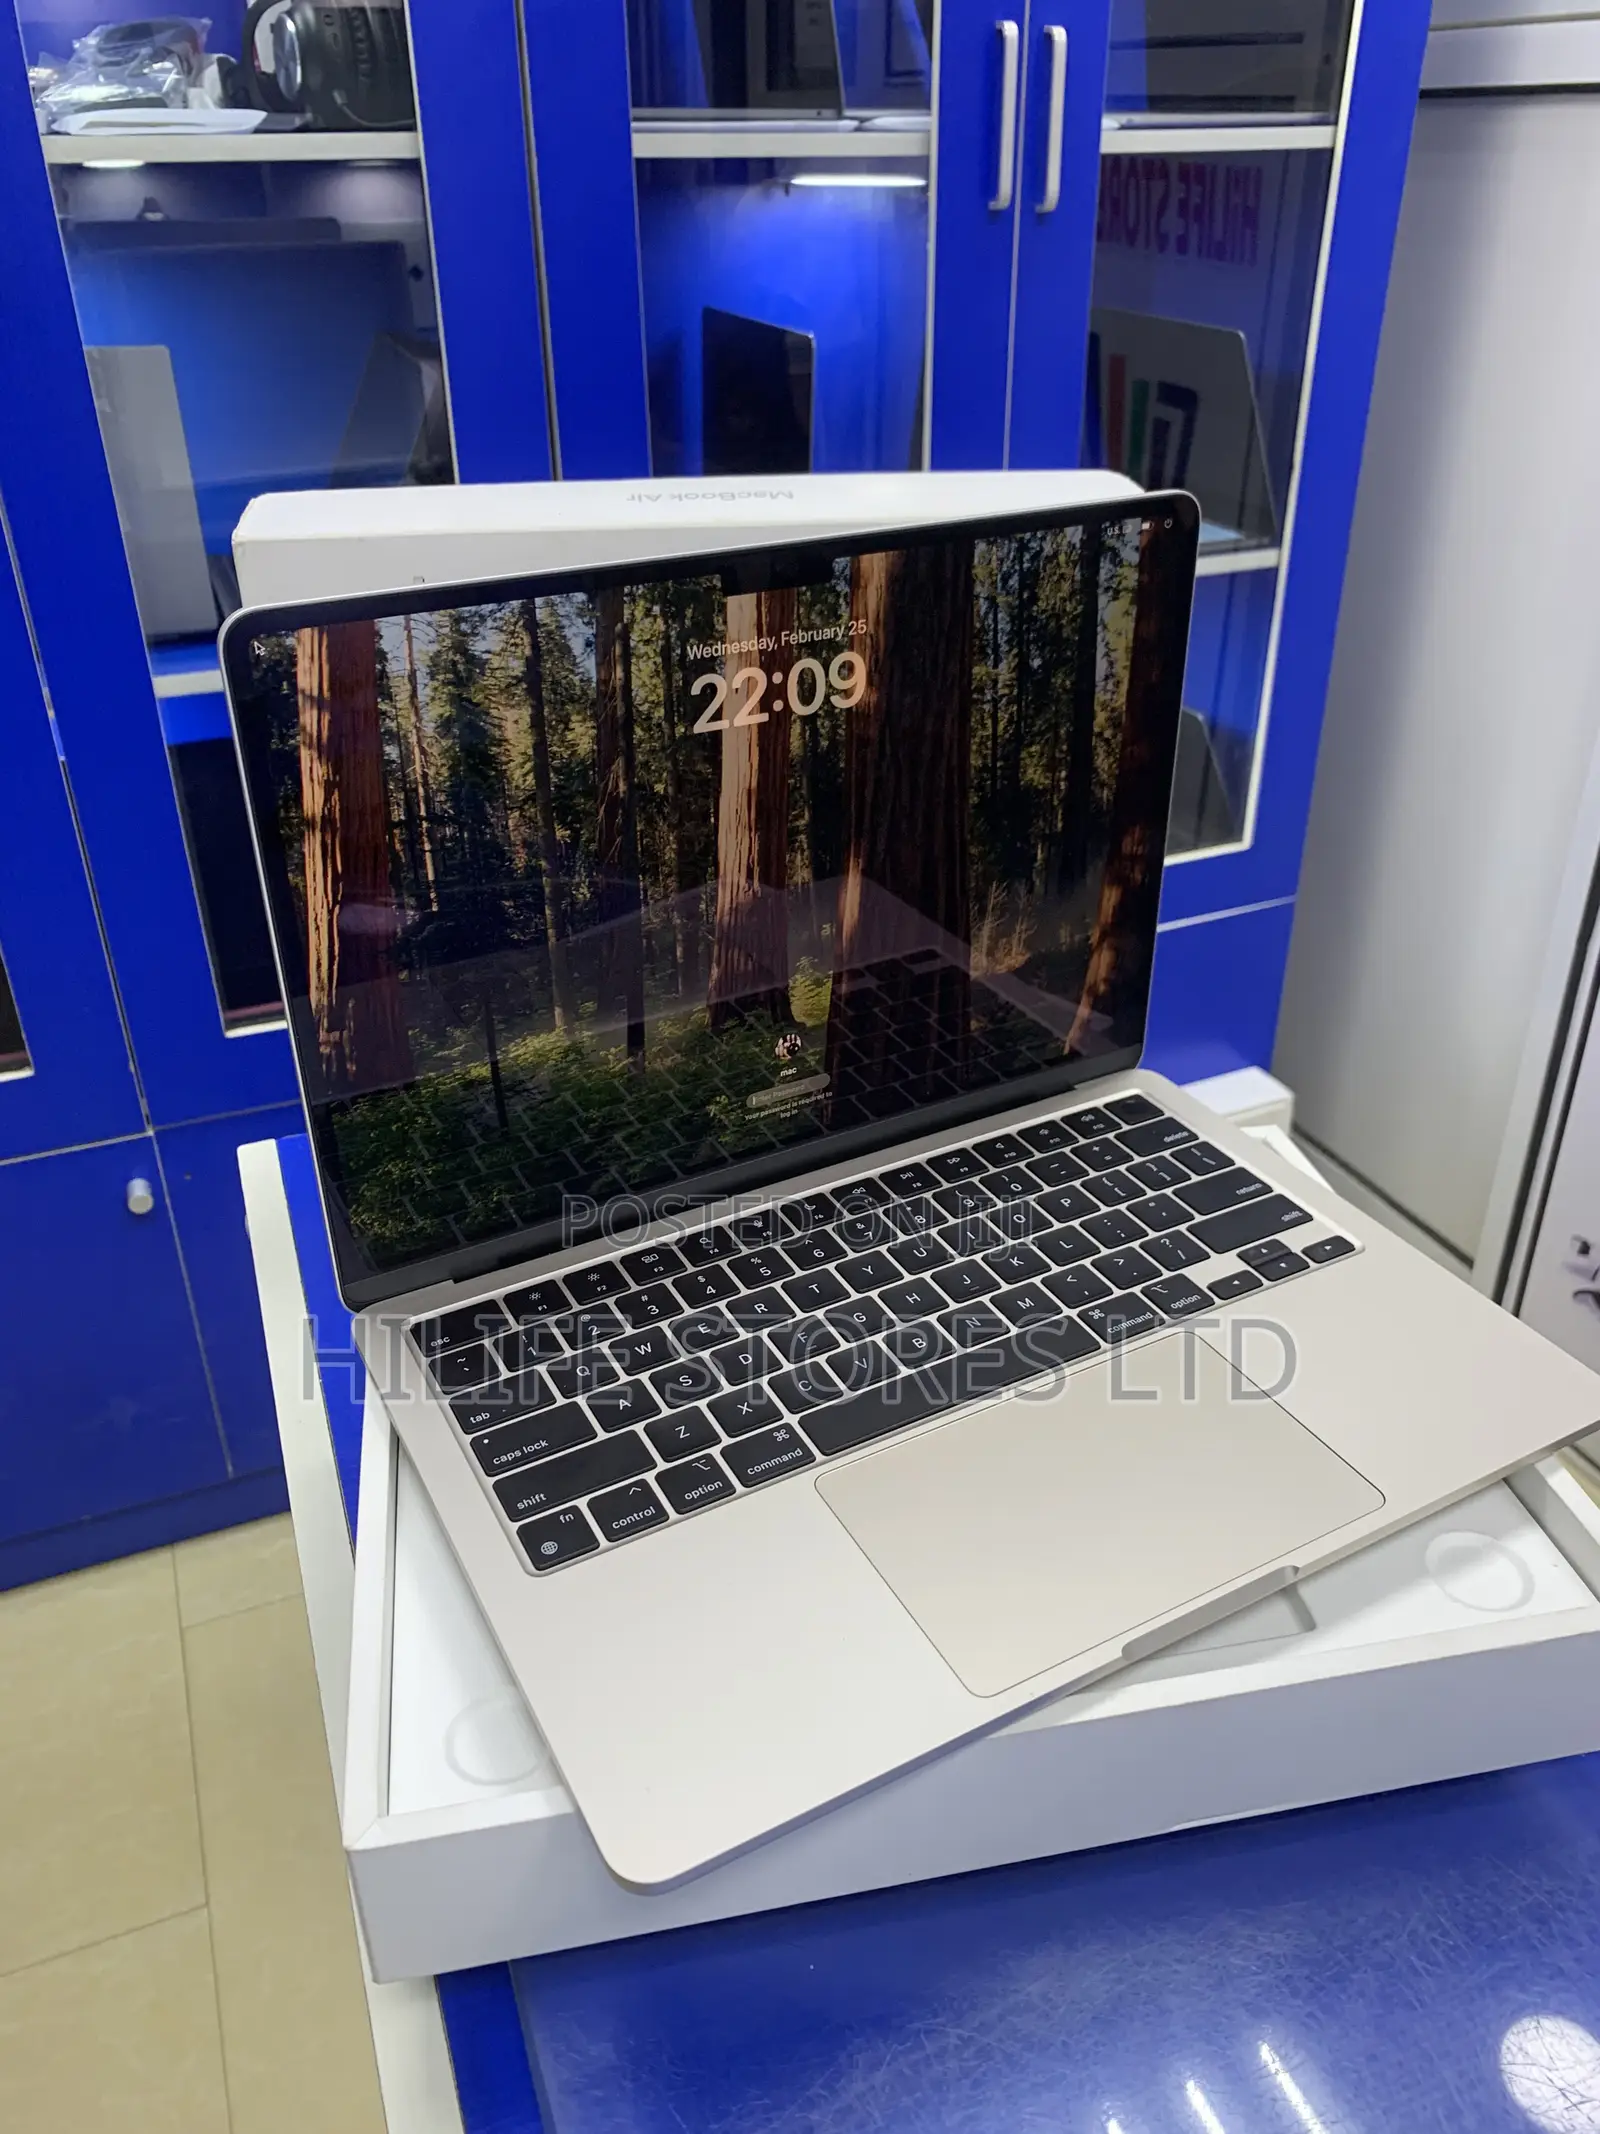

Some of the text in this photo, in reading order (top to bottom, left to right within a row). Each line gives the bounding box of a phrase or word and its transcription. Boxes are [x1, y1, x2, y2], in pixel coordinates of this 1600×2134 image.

[627, 490, 794, 502] MacBook Air
[687, 620, 867, 661] Wednesday, February 25
[691, 651, 867, 734] 22:09
[780, 1067, 797, 1077] mac
[744, 1112, 760, 1121] Your
[760, 1104, 791, 1117] password
[1163, 1130, 1190, 1144] delete
[1010, 1182, 1023, 1192] 0
[1236, 1182, 1263, 1196] return
[962, 1198, 975, 1208] 9
[1060, 1198, 1072, 1208] P
[914, 1214, 926, 1224] 8
[1012, 1214, 1026, 1224] O
[1280, 1210, 1303, 1222] shift
[863, 1230, 874, 1240] 7
[1059, 1240, 1074, 1250] L
[813, 1248, 825, 1258] 6
[912, 1247, 928, 1258] U
[750, 1256, 762, 1265] %
[1009, 1256, 1024, 1267] K
[654, 1266, 664, 1274] F3
[759, 1266, 772, 1277] 5
[861, 1264, 874, 1276] Y
[698, 1275, 706, 1283] $
[962, 1274, 972, 1285] J
[596, 1284, 607, 1292] F2
[706, 1285, 716, 1296] 4
[808, 1283, 821, 1294] T
[904, 1292, 922, 1304] H
[1016, 1297, 1035, 1310] M
[1170, 1292, 1202, 1310] option
[538, 1304, 548, 1312] F1
[647, 1304, 660, 1315] 3
[754, 1303, 769, 1314] R
[580, 1314, 591, 1322] @
[852, 1312, 867, 1323] G
[964, 1316, 982, 1329] N
[1107, 1311, 1154, 1334] command
[588, 1326, 600, 1336] 2
[696, 1322, 711, 1334] E
[430, 1336, 450, 1348] esc
[797, 1332, 808, 1343] F
[911, 1338, 926, 1348] B
[527, 1346, 536, 1356] 1
[634, 1342, 652, 1356] W
[738, 1354, 752, 1364] D
[854, 1357, 868, 1370] V
[576, 1366, 591, 1377] Q
[678, 1374, 692, 1386] S
[798, 1380, 812, 1392] C
[618, 1399, 632, 1410] A
[736, 1402, 754, 1416] X
[470, 1411, 490, 1424] tab
[674, 1426, 690, 1440] Z
[493, 1439, 549, 1465] caps lock
[747, 1447, 804, 1476] command
[684, 1480, 723, 1501] option
[516, 1492, 547, 1510] shift
[559, 1512, 574, 1524] fn
[612, 1505, 656, 1530] control
